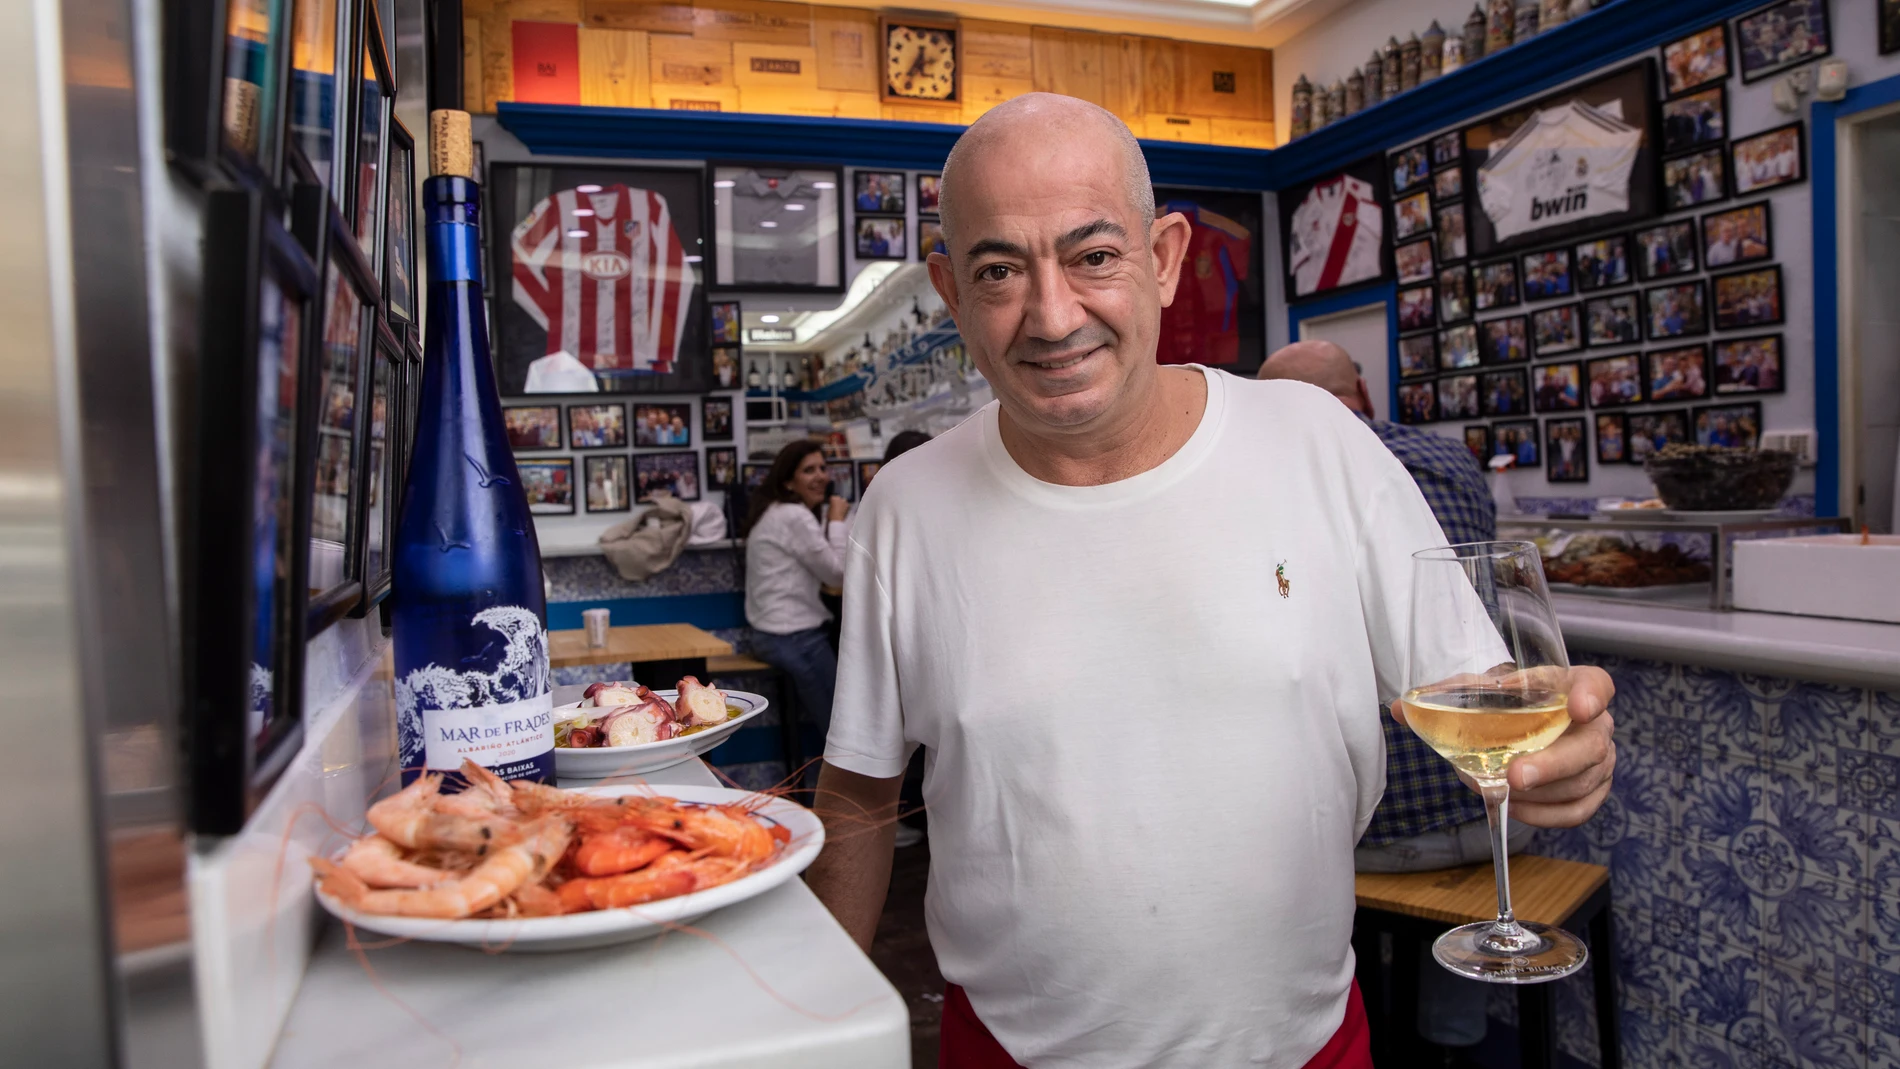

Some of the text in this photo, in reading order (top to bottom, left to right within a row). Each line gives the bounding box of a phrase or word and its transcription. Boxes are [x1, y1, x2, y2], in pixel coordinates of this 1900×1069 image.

[1530, 187, 1588, 222] bwin
[590, 257, 624, 273] KIA
[440, 712, 550, 743] MAR DE FRADES
[457, 734, 543, 753] ALBARIÑO ATLÁNTICO
[498, 749, 516, 757] 2020
[506, 762, 535, 775] BAIXAS
[1526, 965, 1566, 975] BILBAO
